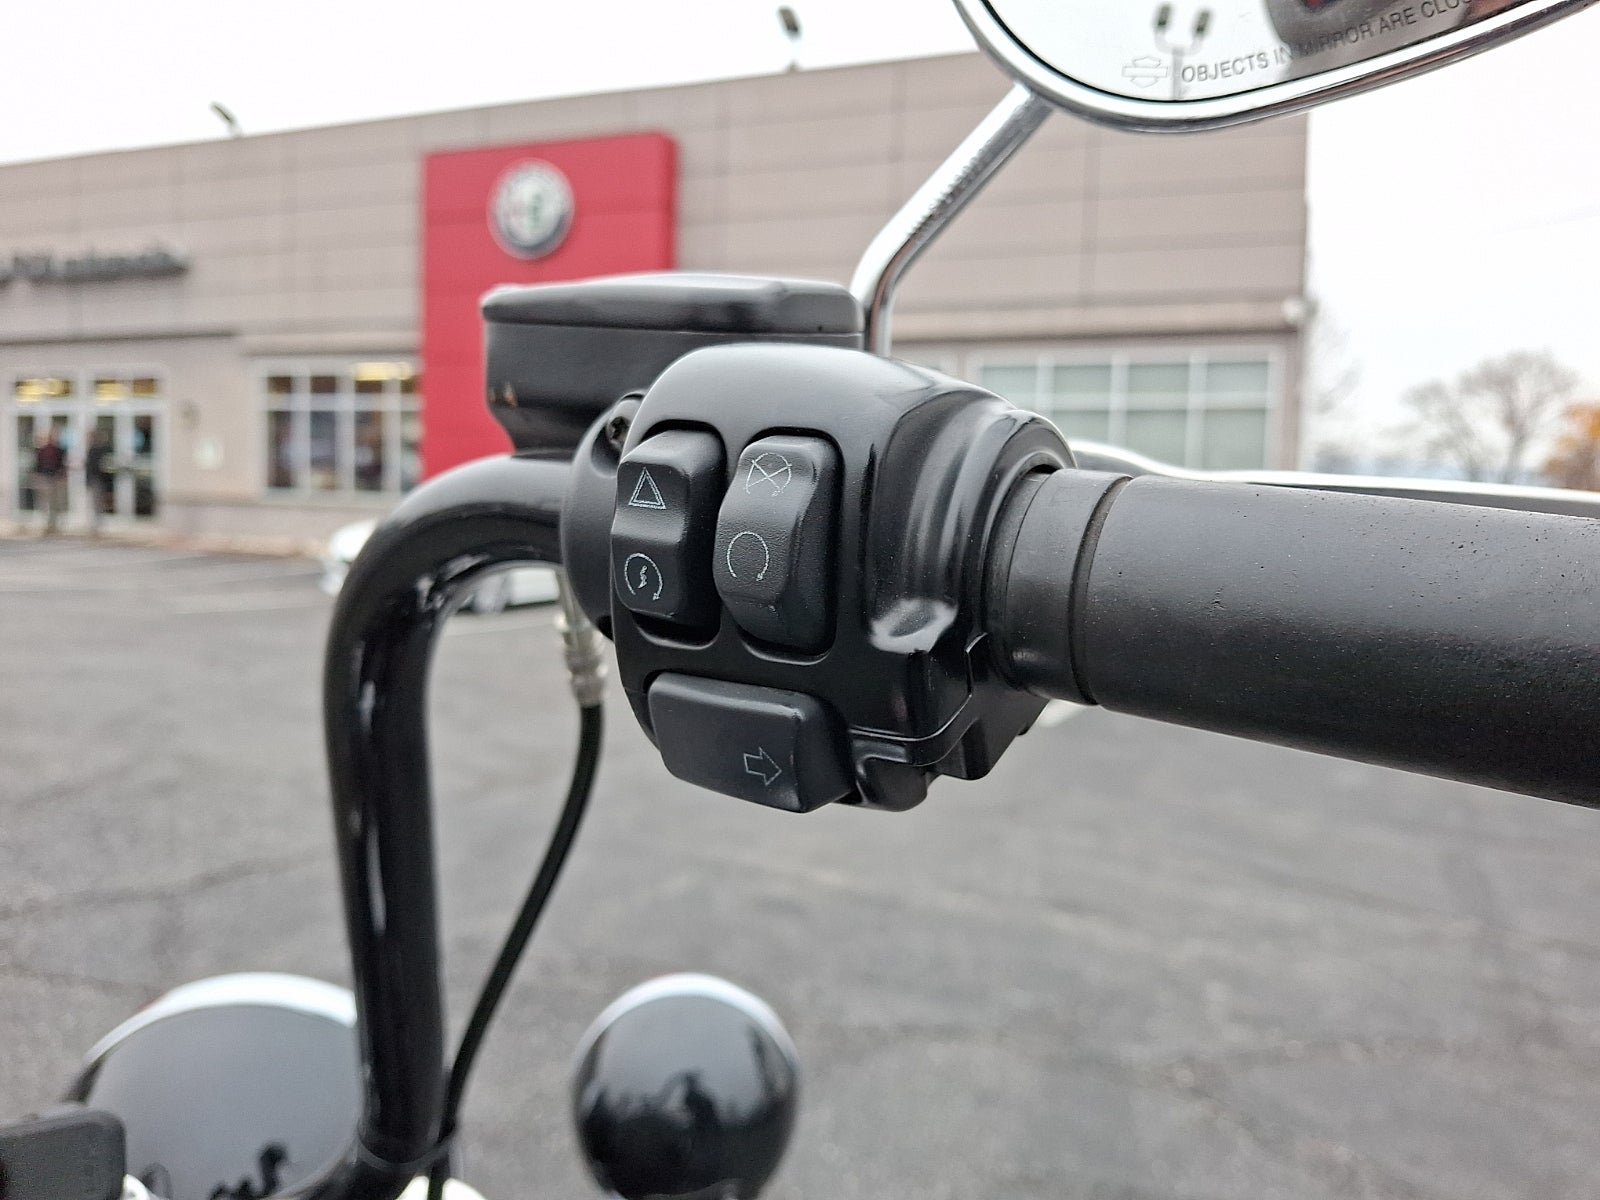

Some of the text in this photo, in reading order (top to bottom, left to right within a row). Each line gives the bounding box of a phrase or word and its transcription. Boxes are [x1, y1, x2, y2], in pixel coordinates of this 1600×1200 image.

[1181, 52, 1269, 83] OBJECTS
[1273, 44, 1293, 65] IN
[1379, 7, 1417, 34] ARE
[1421, 0, 1471, 18] CLO
